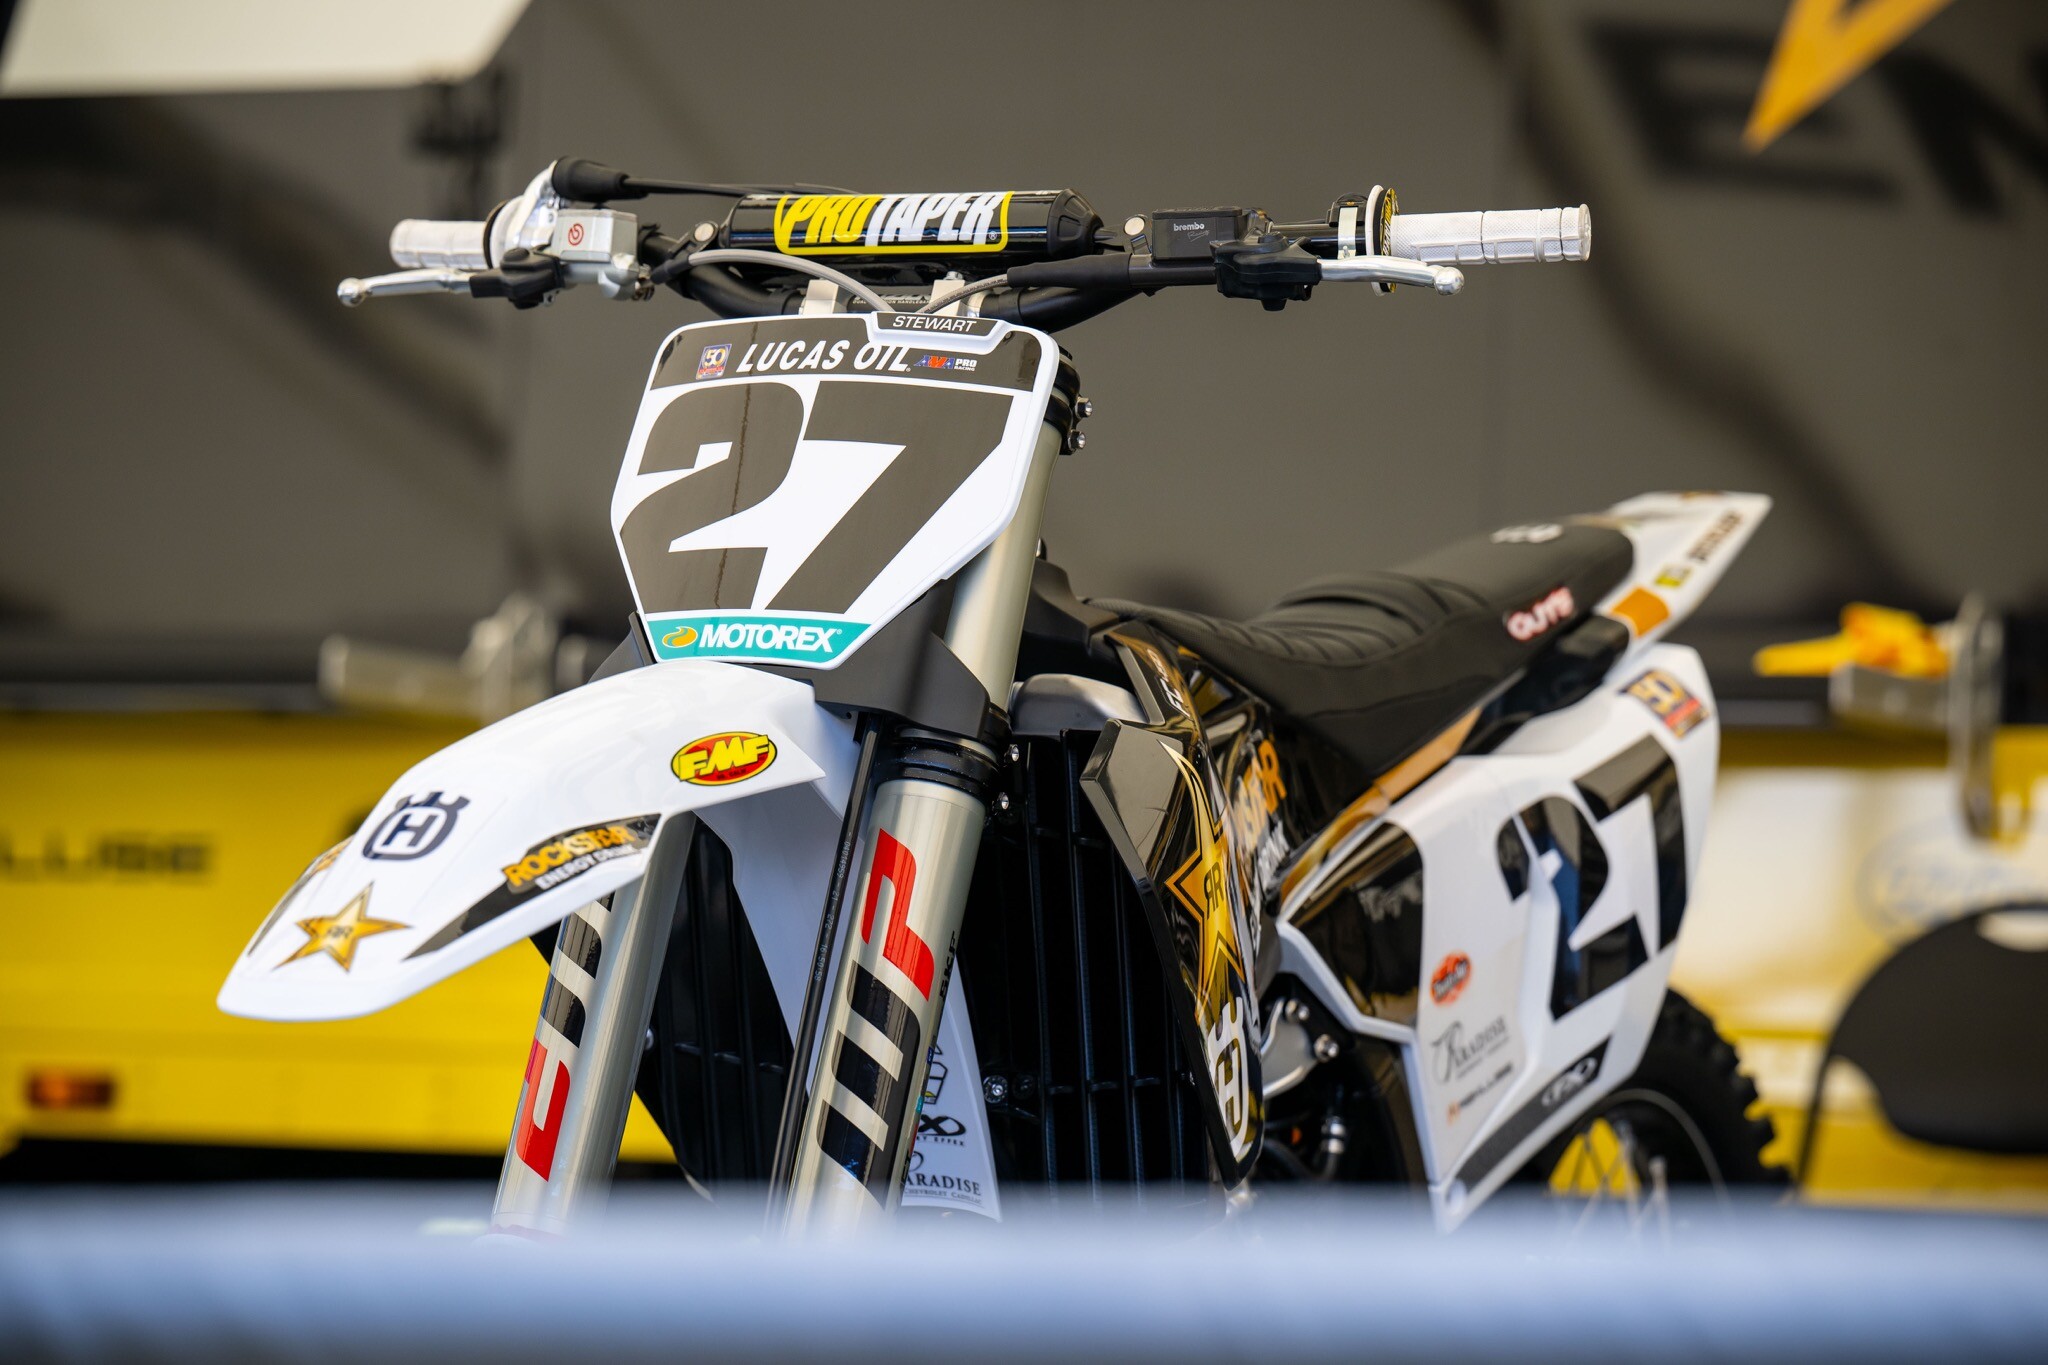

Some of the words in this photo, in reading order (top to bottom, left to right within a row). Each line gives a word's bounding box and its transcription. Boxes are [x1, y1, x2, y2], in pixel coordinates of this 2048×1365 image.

[778, 192, 1004, 248] PROTAPER
[1173, 221, 1205, 231] brembo
[892, 315, 978, 333] STEWART
[736, 340, 851, 373] LUCAS
[853, 342, 909, 372] OIL
[914, 354, 956, 370] AMA
[955, 358, 978, 368] PRO
[619, 381, 1014, 615] 27
[700, 623, 838, 653] MOTOREX
[679, 735, 770, 782] FMF
[502, 825, 635, 888] ROCKSTAR
[534, 854, 597, 891] ENERGY
